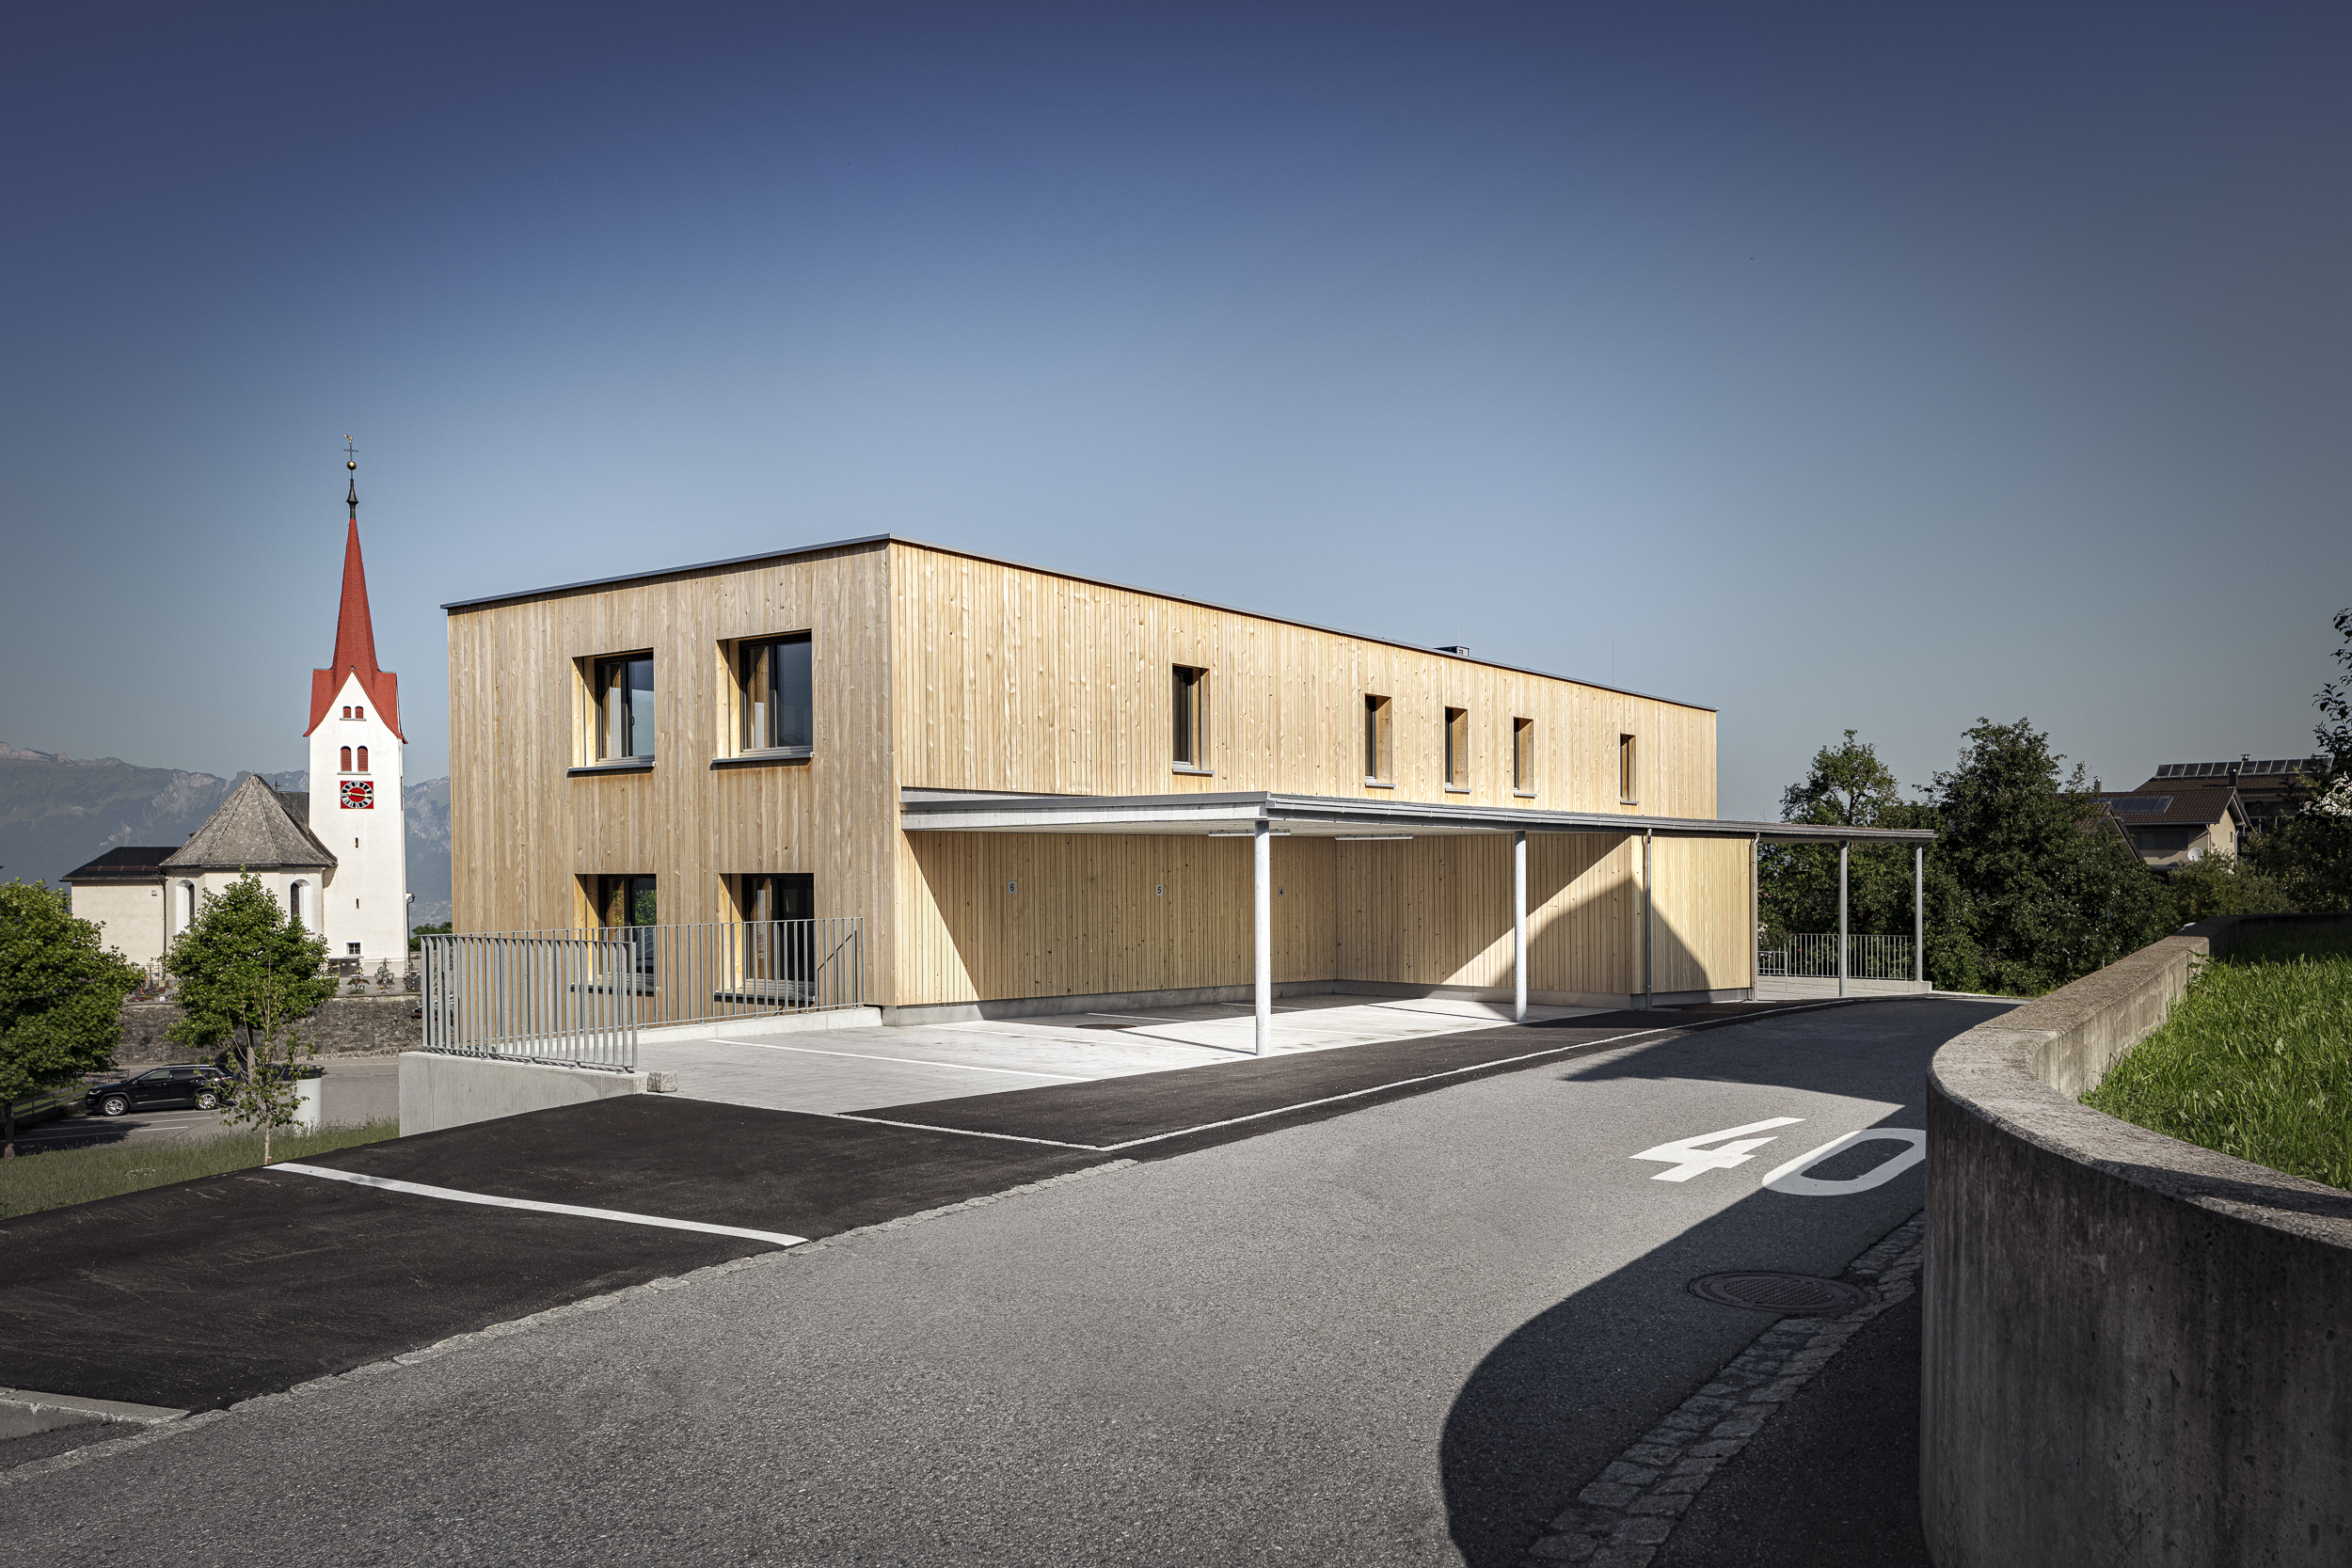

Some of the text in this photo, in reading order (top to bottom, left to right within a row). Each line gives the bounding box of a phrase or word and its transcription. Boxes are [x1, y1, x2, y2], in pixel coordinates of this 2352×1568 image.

[1009, 882, 1015, 892] 6
[1157, 886, 1162, 895] 5
[1629, 1117, 1926, 1196] 40
